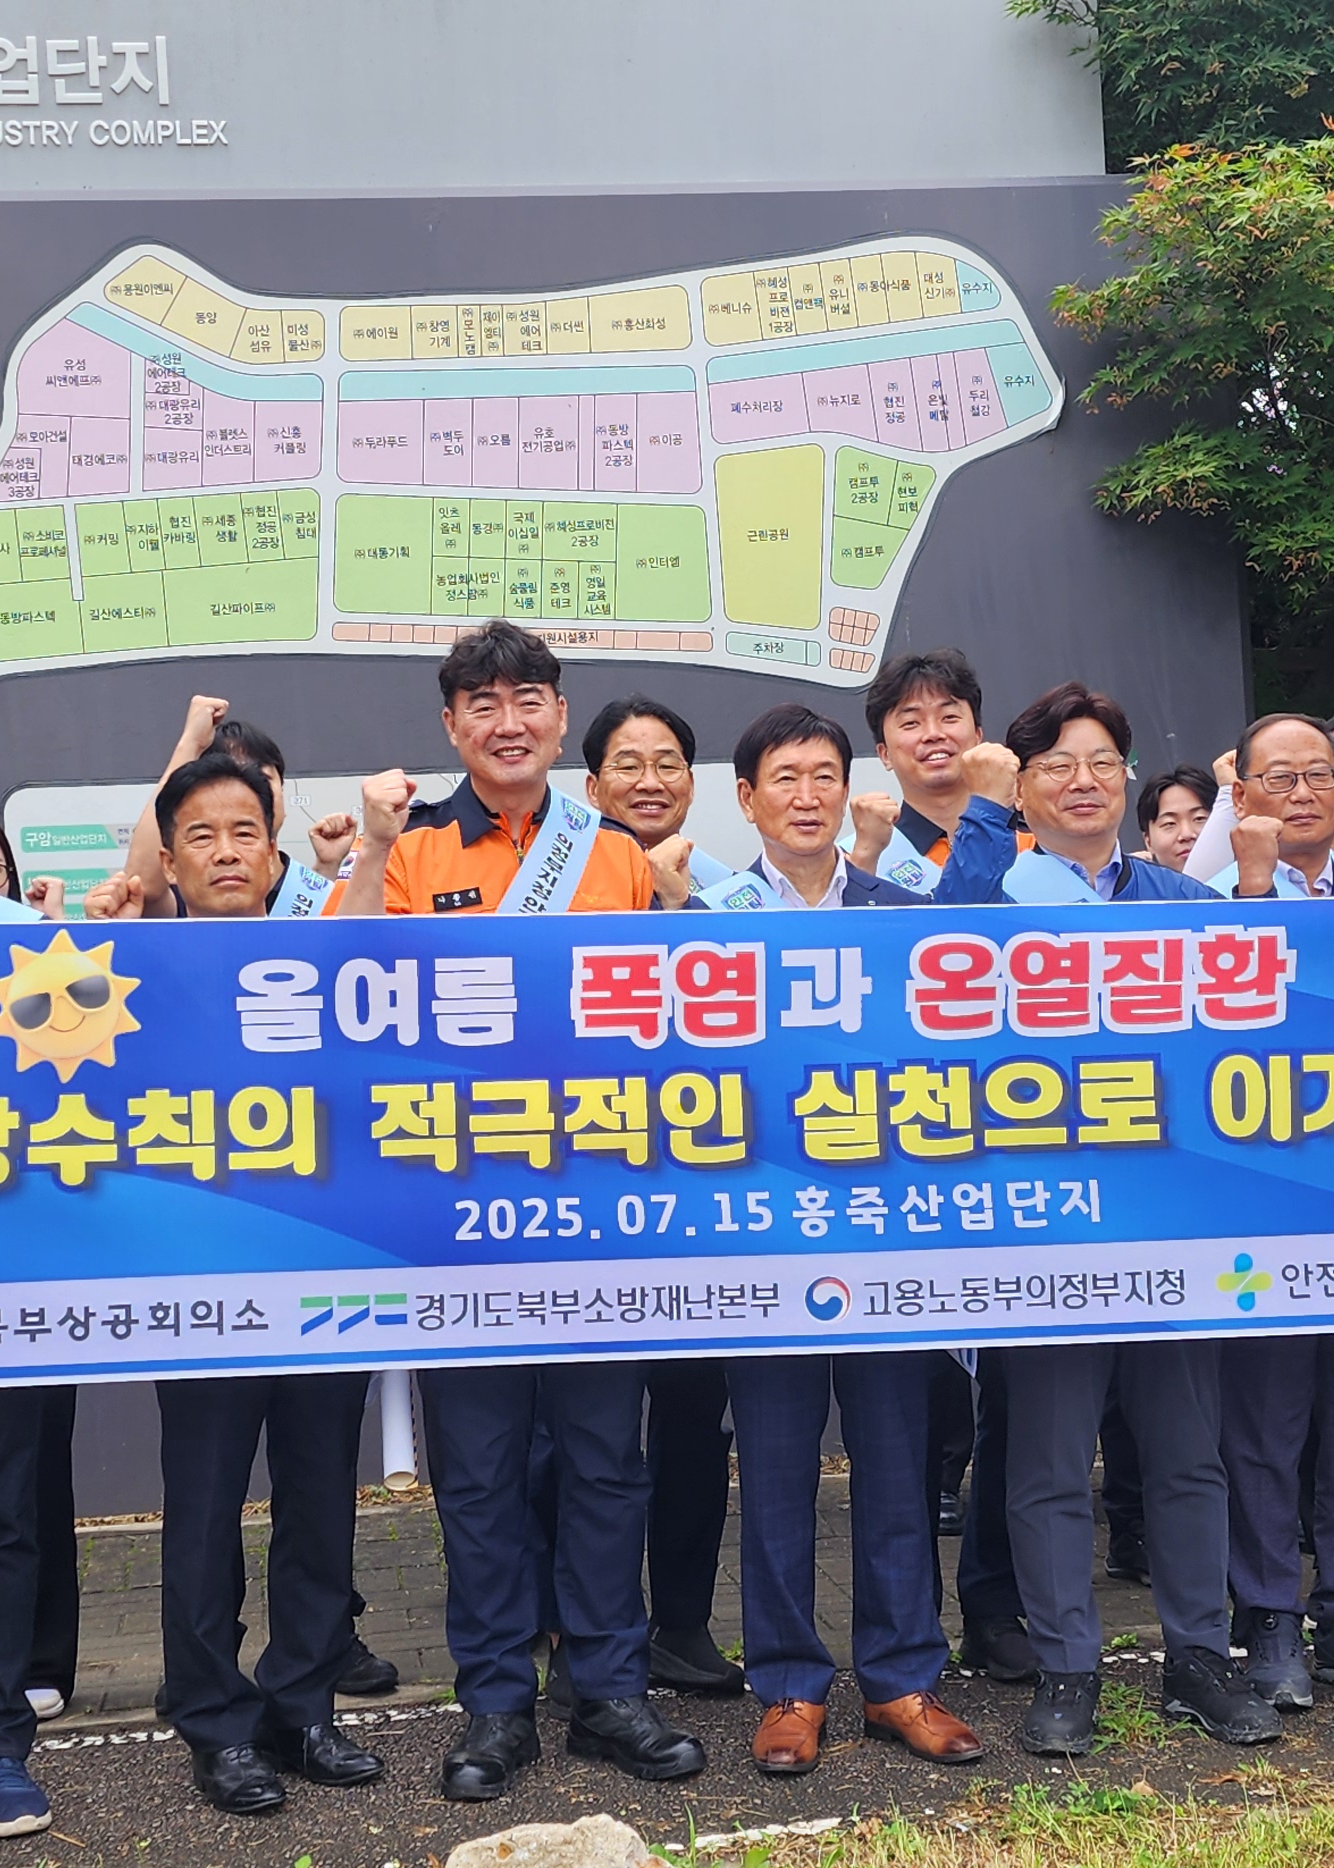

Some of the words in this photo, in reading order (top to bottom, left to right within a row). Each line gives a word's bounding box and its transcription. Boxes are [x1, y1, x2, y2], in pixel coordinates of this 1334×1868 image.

[89, 119, 229, 147] COMPLEX
[769, 292, 789, 303] 프로
[248, 324, 270, 337] 아산
[63, 358, 86, 372] 유성
[164, 413, 194, 425] 2공장
[851, 491, 878, 504] 2공장
[252, 536, 280, 550] 2공장
[25, 832, 51, 848] 구암
[236, 956, 517, 1053] 올여름
[572, 941, 873, 1050] 폭염과
[910, 930, 1293, 1036] 온열질환
[371, 1073, 746, 1173] 적극적인
[794, 1061, 1161, 1167] 실천으로
[454, 1197, 601, 1241] 2025.
[617, 1193, 696, 1238] 07.
[714, 1190, 772, 1234] 15
[792, 1178, 1102, 1238] 홍죽산업단지
[863, 1268, 1187, 1318] 고용노동부의정부지청
[415, 1282, 780, 1332] 경기도북부소방재난본부
